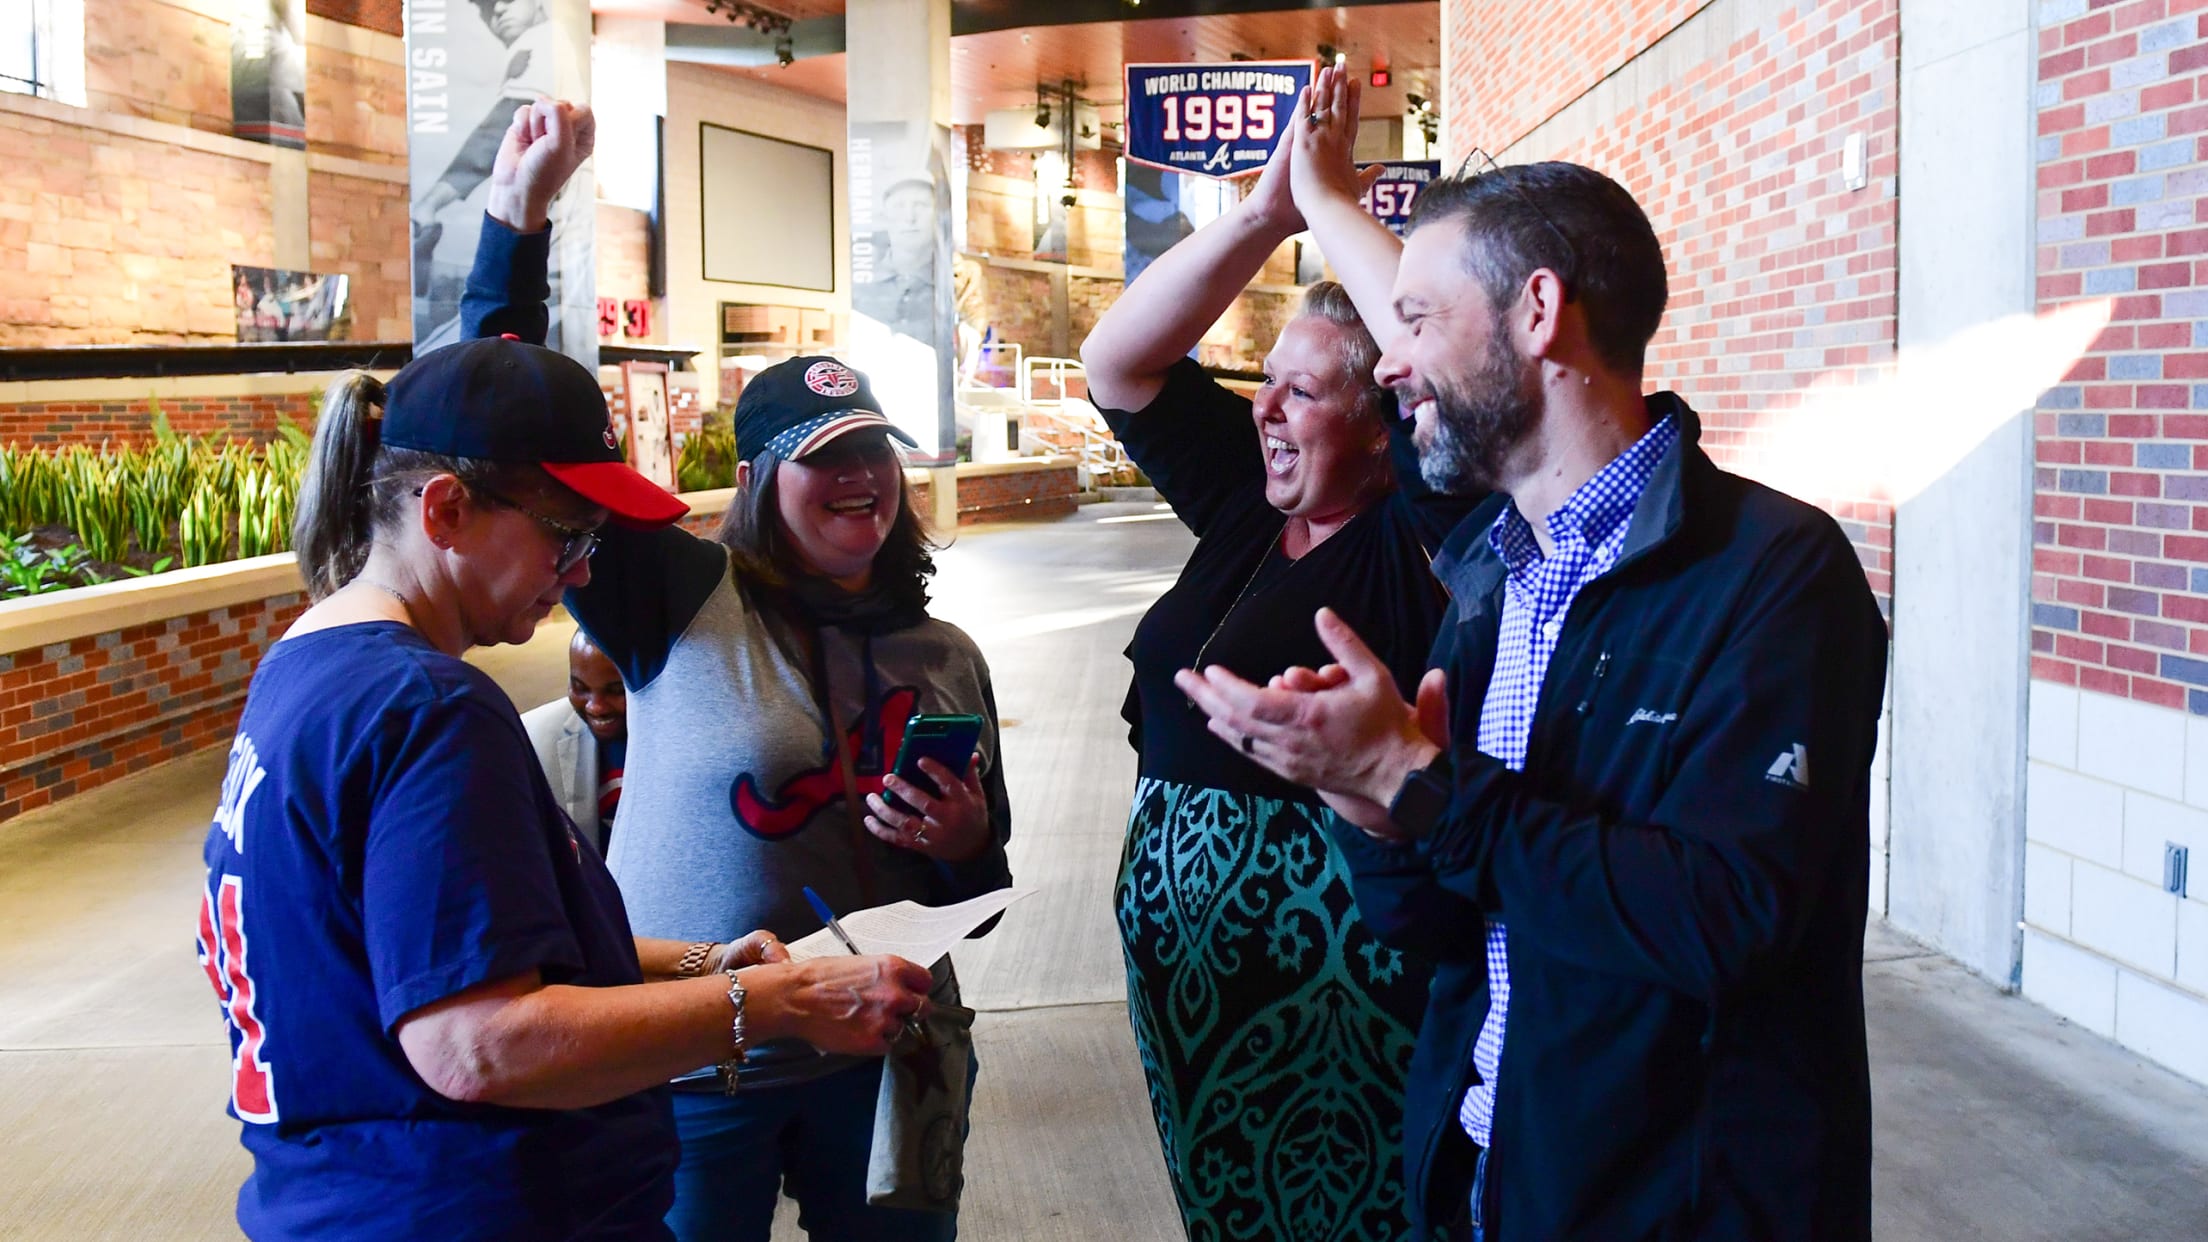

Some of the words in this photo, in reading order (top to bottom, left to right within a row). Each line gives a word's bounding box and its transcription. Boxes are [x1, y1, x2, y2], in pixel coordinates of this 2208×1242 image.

[412, 48, 448, 133] SAIN
[1145, 73, 1198, 96] WORLD
[1201, 71, 1296, 95] CHAMPIONS
[1162, 94, 1276, 141] 1995
[1169, 150, 1207, 161] ATLANTA
[1233, 149, 1268, 161] BRAVES
[1379, 166, 1430, 182] MPIONS
[851, 138, 873, 224] HERMAN
[852, 232, 873, 283] LONG
[623, 300, 651, 337] 31
